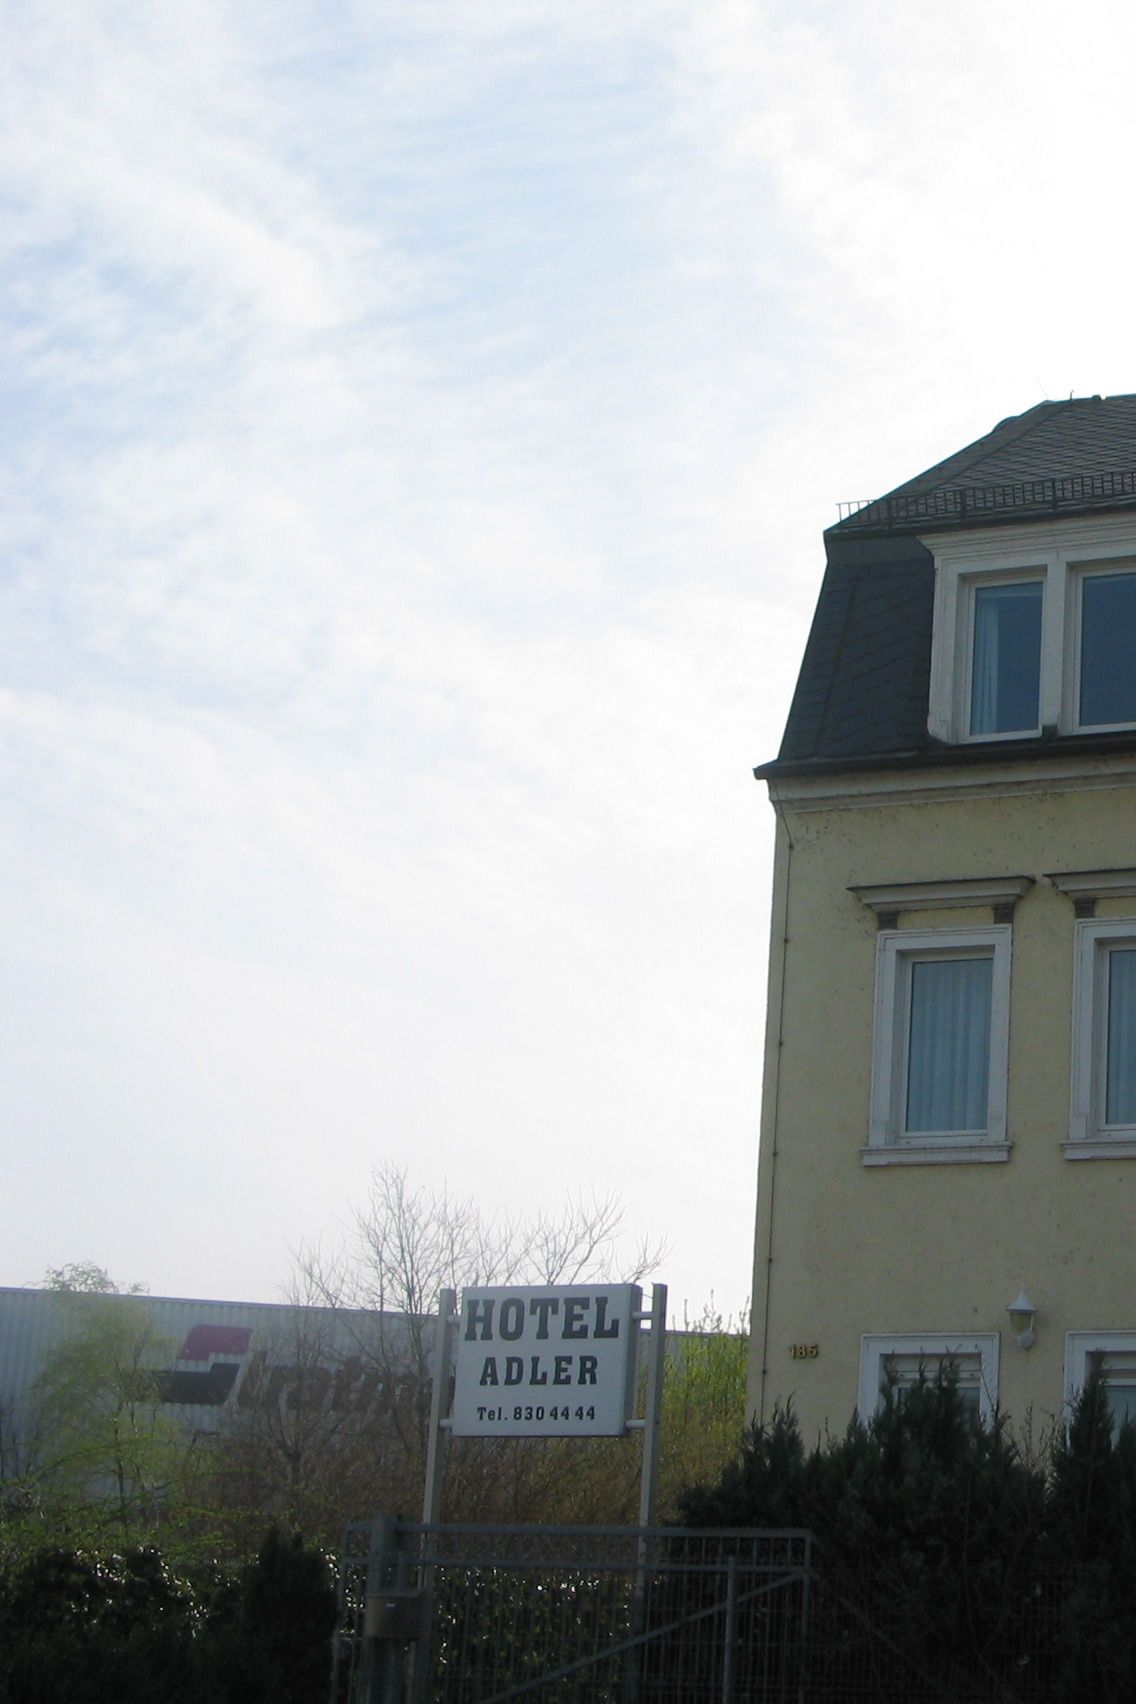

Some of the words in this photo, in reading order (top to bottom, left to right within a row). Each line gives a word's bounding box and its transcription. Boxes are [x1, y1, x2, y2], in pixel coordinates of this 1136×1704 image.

[464, 1296, 620, 1341] HOTEL
[790, 1343, 819, 1360] 185
[479, 1355, 598, 1386] ADLER
[476, 1405, 508, 1421] Tel.
